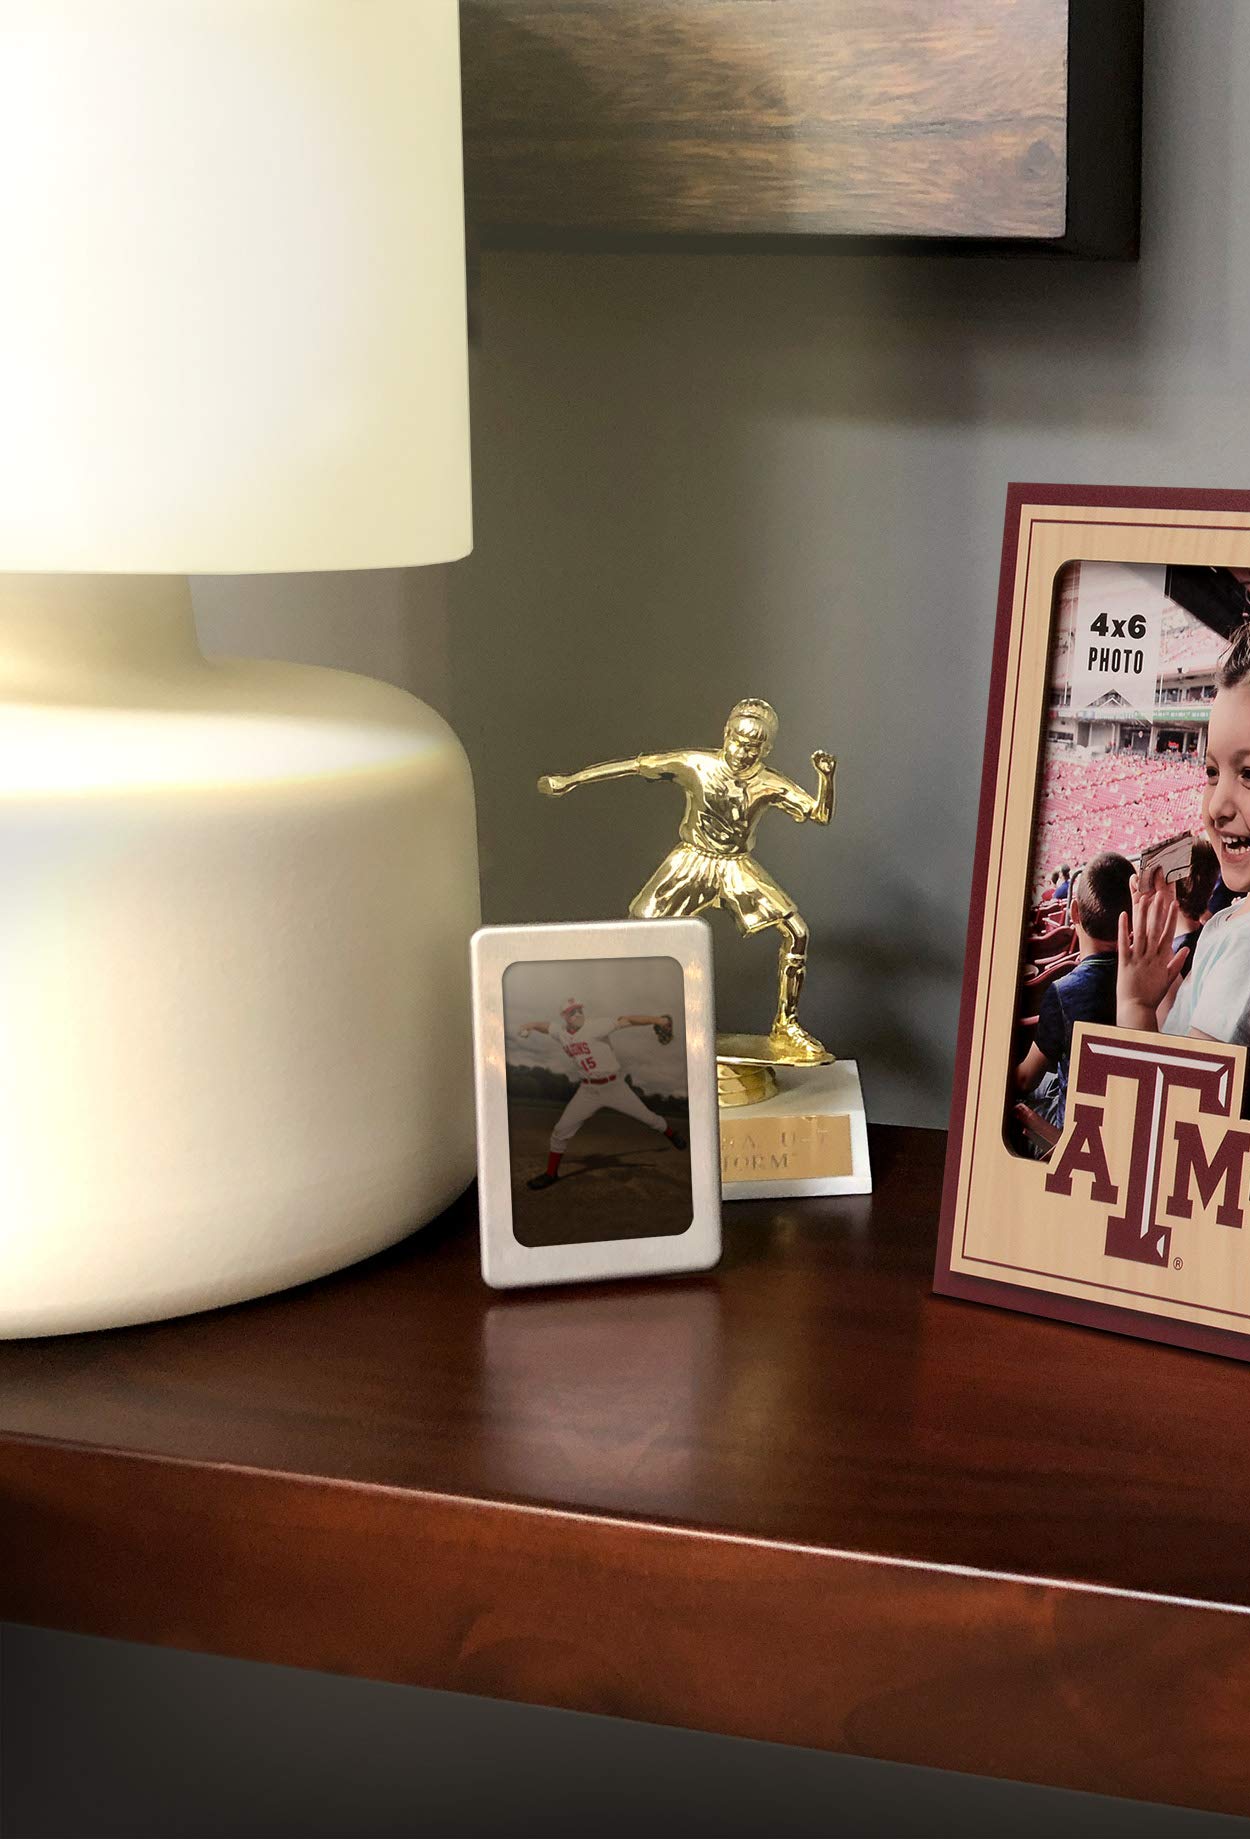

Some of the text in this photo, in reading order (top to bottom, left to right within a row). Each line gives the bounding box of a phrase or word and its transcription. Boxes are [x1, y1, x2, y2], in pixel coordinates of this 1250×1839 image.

[1090, 613, 1147, 640] 4x6
[1088, 647, 1144, 674] PHOTO
[580, 1056, 596, 1073] 15
